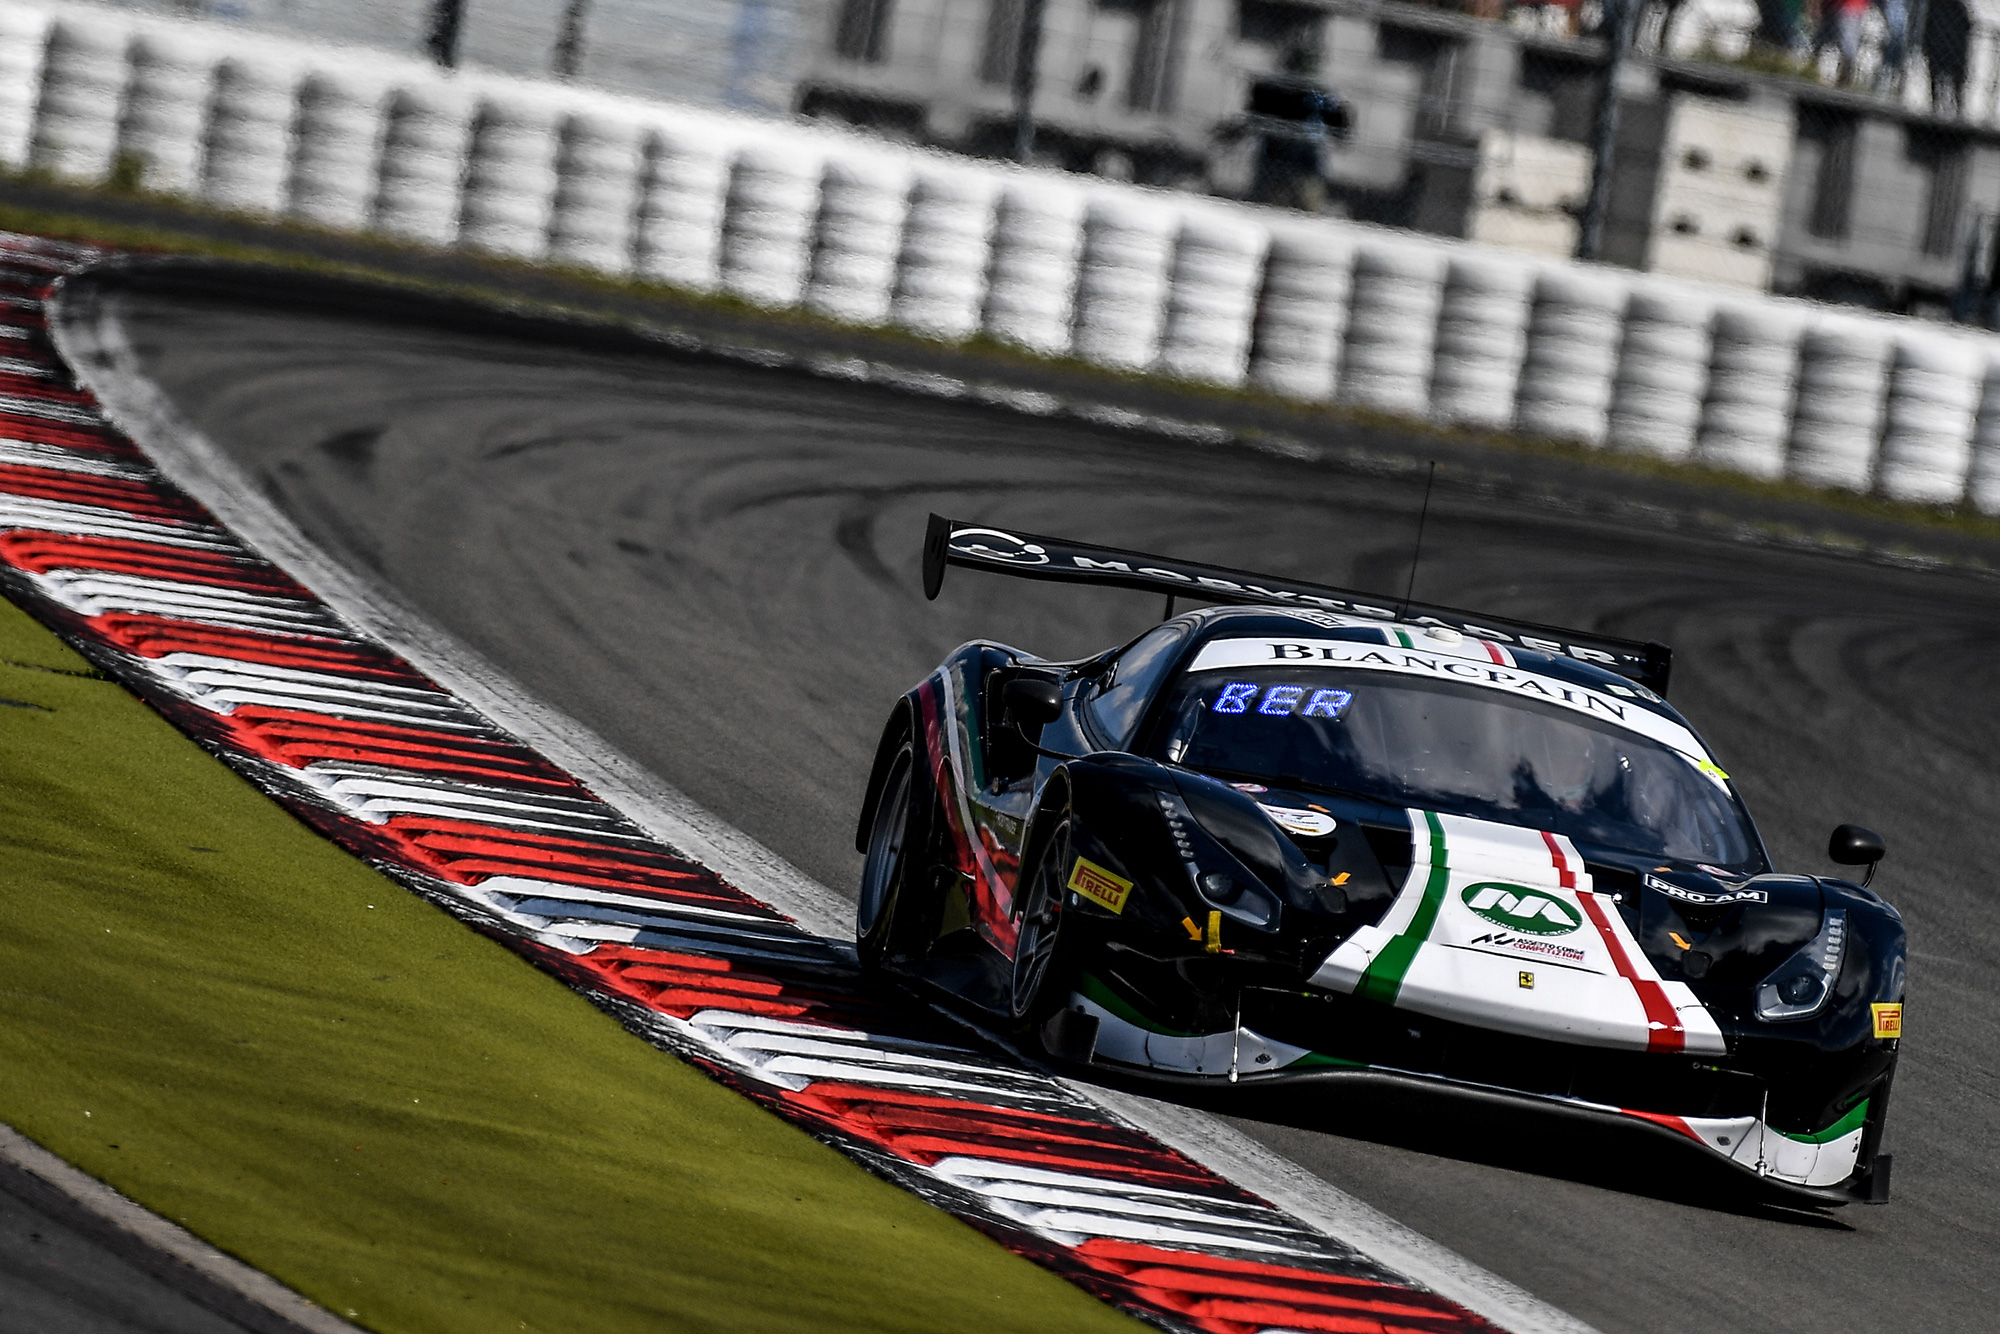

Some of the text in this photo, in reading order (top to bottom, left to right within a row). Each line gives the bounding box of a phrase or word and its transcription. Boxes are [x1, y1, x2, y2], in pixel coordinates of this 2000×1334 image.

[1266, 643, 1629, 721] BLANCPAIN
[1213, 682, 1352, 717] BER
[1074, 865, 1125, 906] PIRELLI
[1650, 879, 1761, 903] PRO-AM
[1475, 910, 1515, 931] CLOSING
[1517, 938, 1555, 950] ASSETTO
